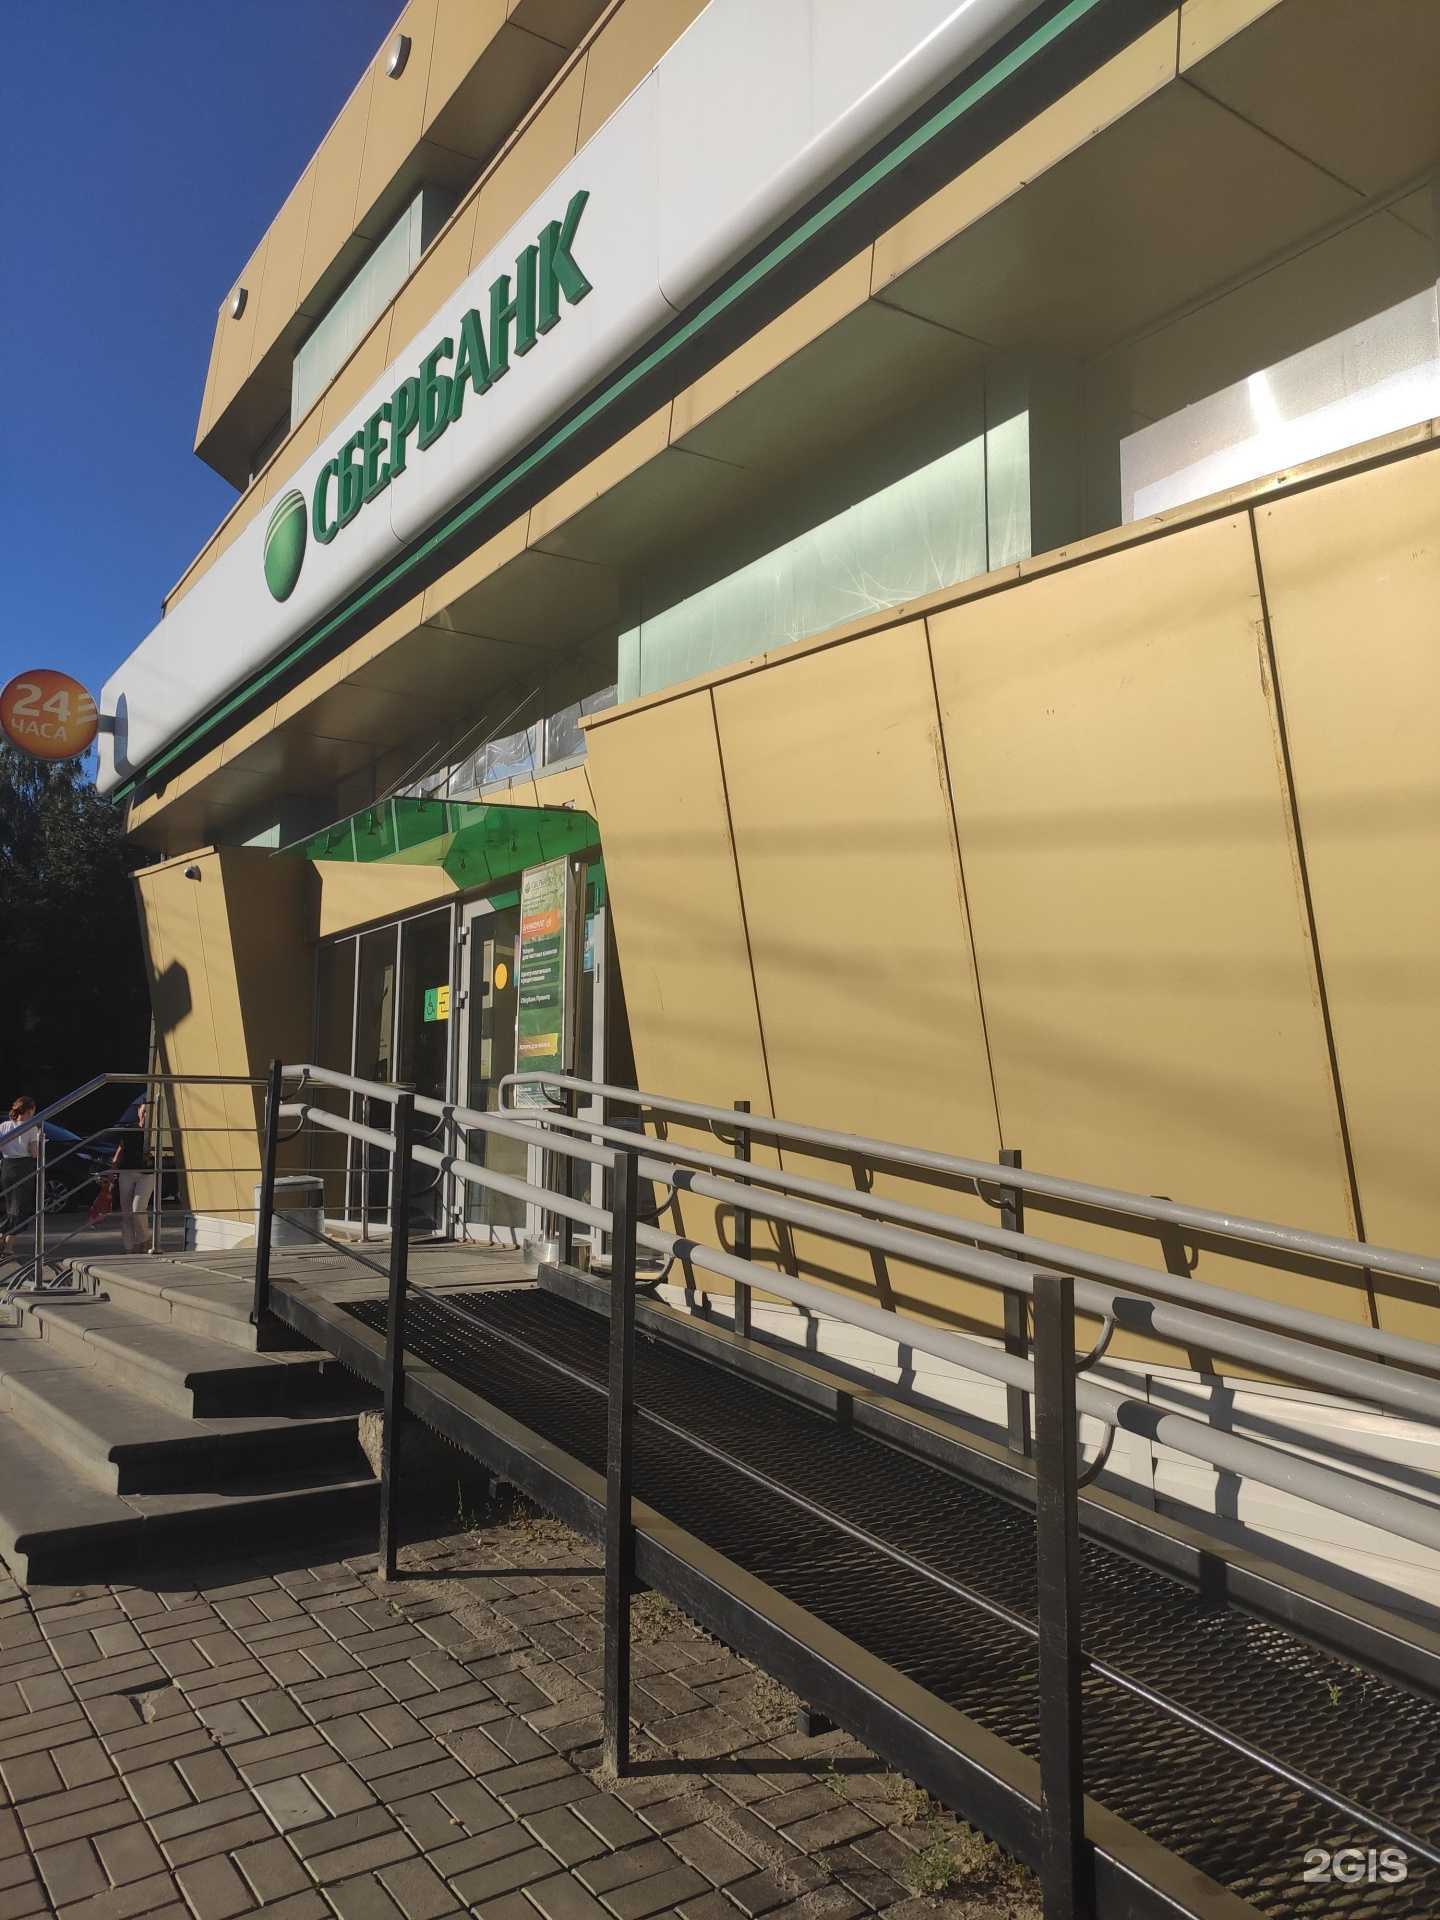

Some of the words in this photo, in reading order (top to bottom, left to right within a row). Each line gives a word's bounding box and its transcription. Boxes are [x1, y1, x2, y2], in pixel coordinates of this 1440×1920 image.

[312, 190, 592, 544] СБЕРБАНК
[12, 683, 70, 722] 24
[11, 717, 68, 742] ЧАСА
